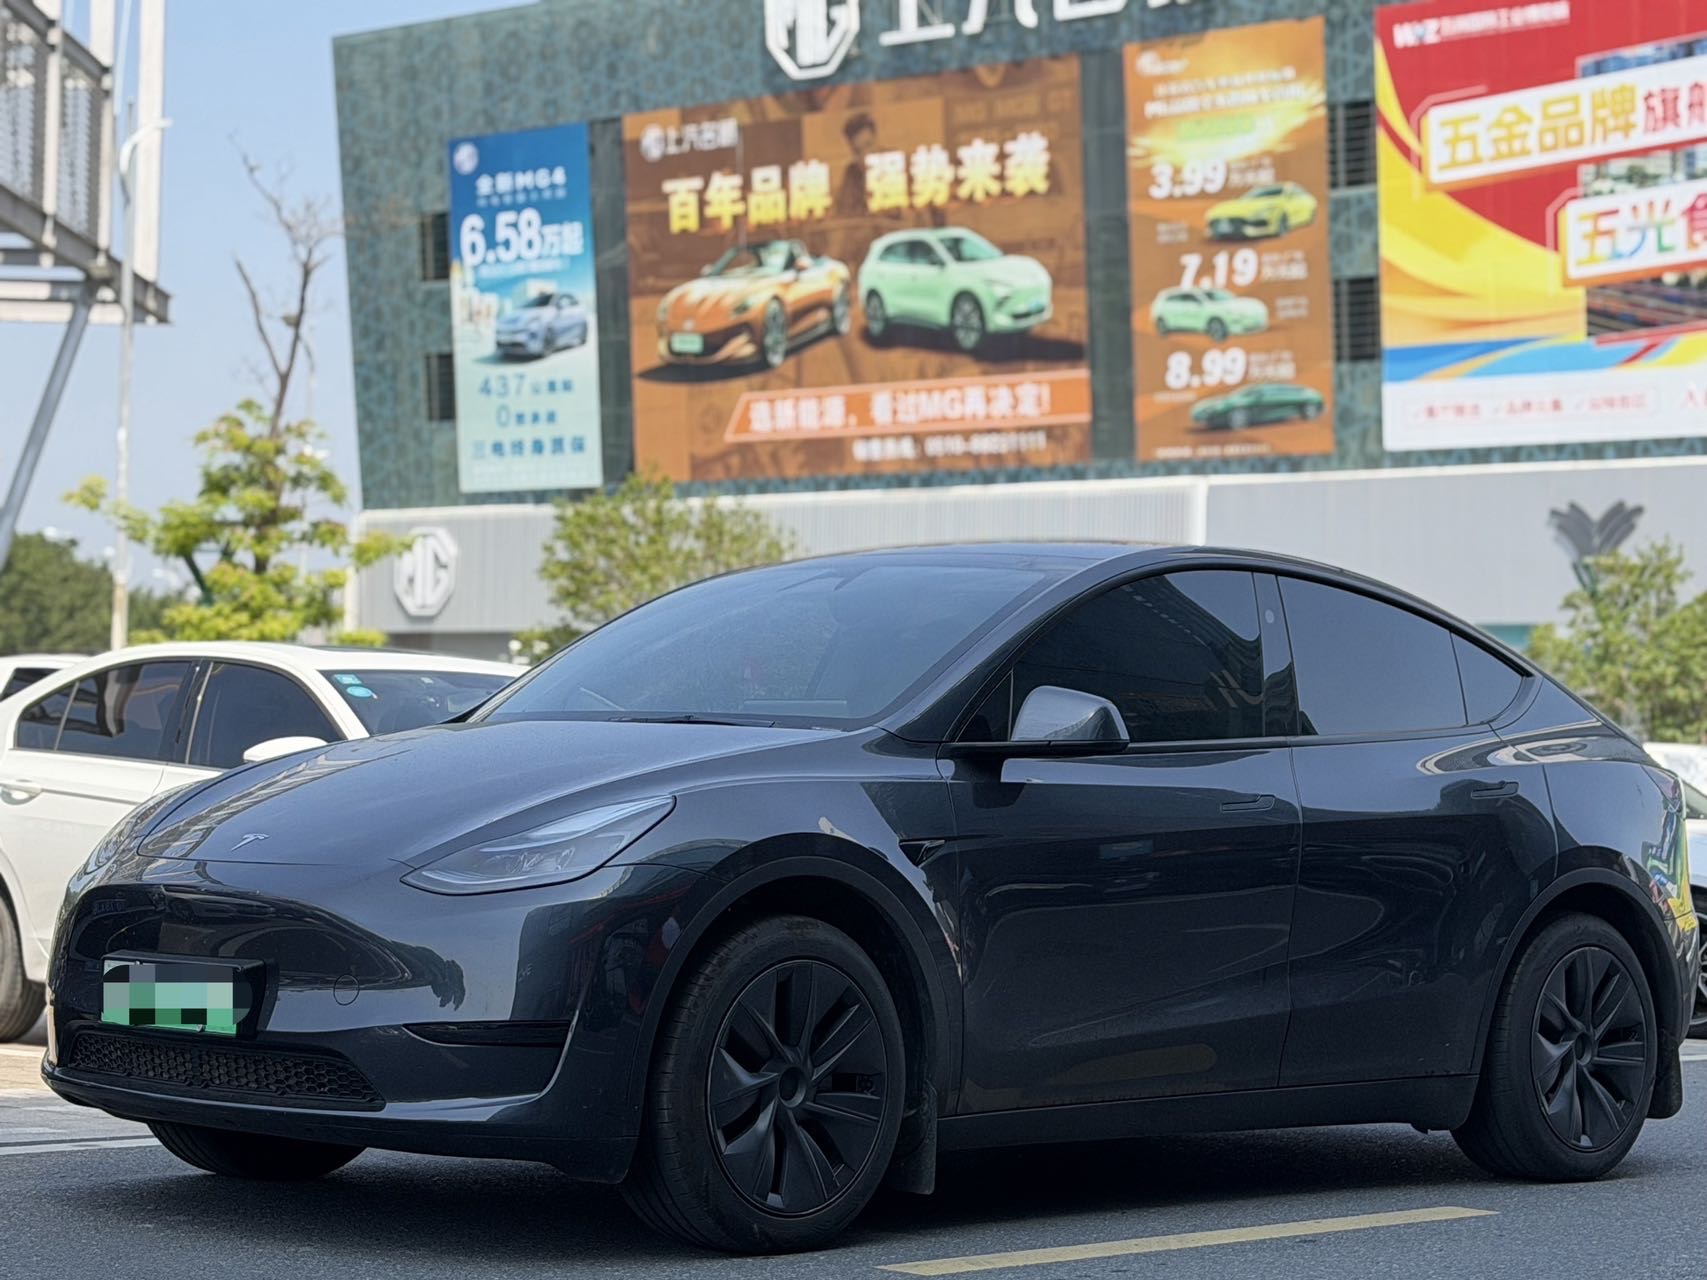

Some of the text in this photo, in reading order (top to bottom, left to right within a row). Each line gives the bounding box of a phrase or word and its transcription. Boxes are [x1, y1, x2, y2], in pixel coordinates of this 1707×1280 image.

[661, 130, 1051, 236] 百年品牌 强势来袭
[1148, 159, 1227, 200] 3.99
[1179, 248, 1259, 290] 7.19
[1164, 347, 1247, 390] 8.99
[393, 526, 459, 617] MG
